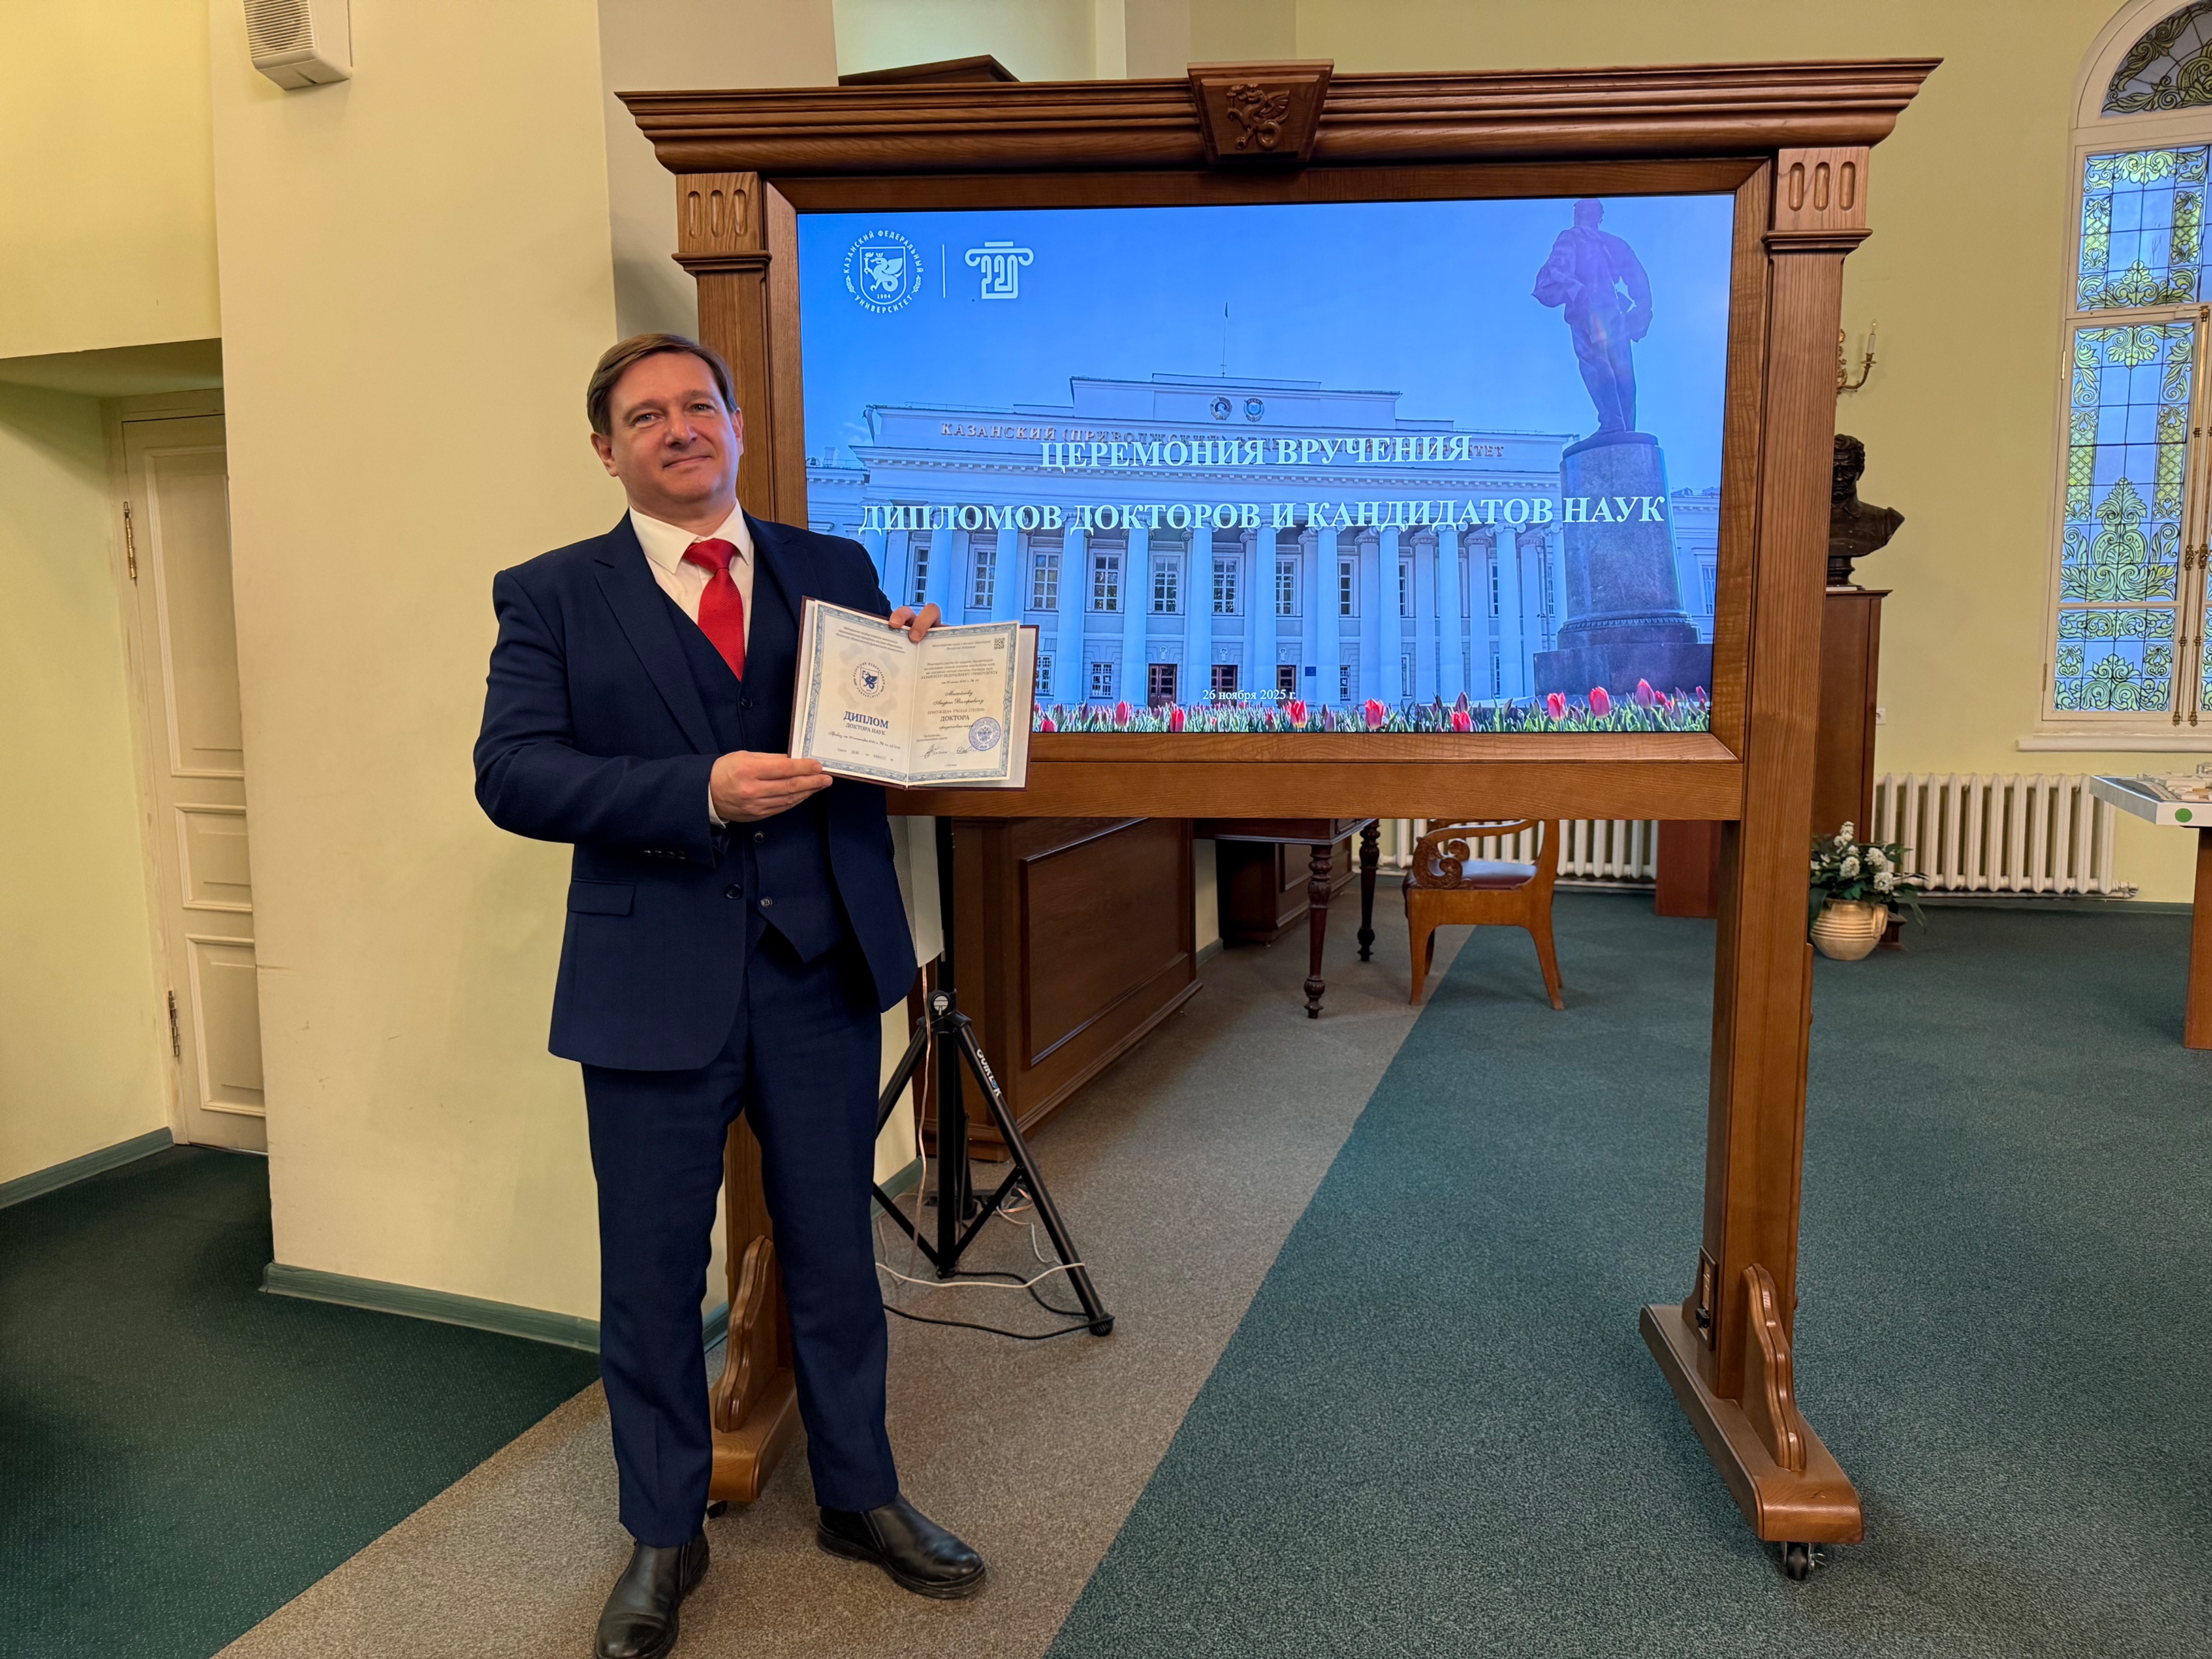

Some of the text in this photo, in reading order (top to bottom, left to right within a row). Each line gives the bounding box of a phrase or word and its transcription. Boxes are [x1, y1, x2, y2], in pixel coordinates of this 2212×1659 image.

[843, 230, 924, 273] КАЗАНСКИЙ ФЕДЕРАЛЬНЫЙ
[854, 294, 912, 313] УНИВЕРСИТЕТ
[940, 422, 1057, 441] КАЗАНСКИЙ
[1040, 439, 1266, 473] ЦЕРЕМОНИЯ
[1275, 436, 1472, 465] ВРУЧЕНИЯ
[858, 496, 1666, 537] ДИПЛОМОВ ДОКТОРОВ И КАНДИДАТОВ НАУК
[1203, 690, 1216, 700] 26
[1218, 690, 1257, 702] ноября
[1260, 690, 1286, 700] 2025
[843, 711, 889, 729] ДИПЛОМ
[845, 723, 871, 732] ДОКТОРА
